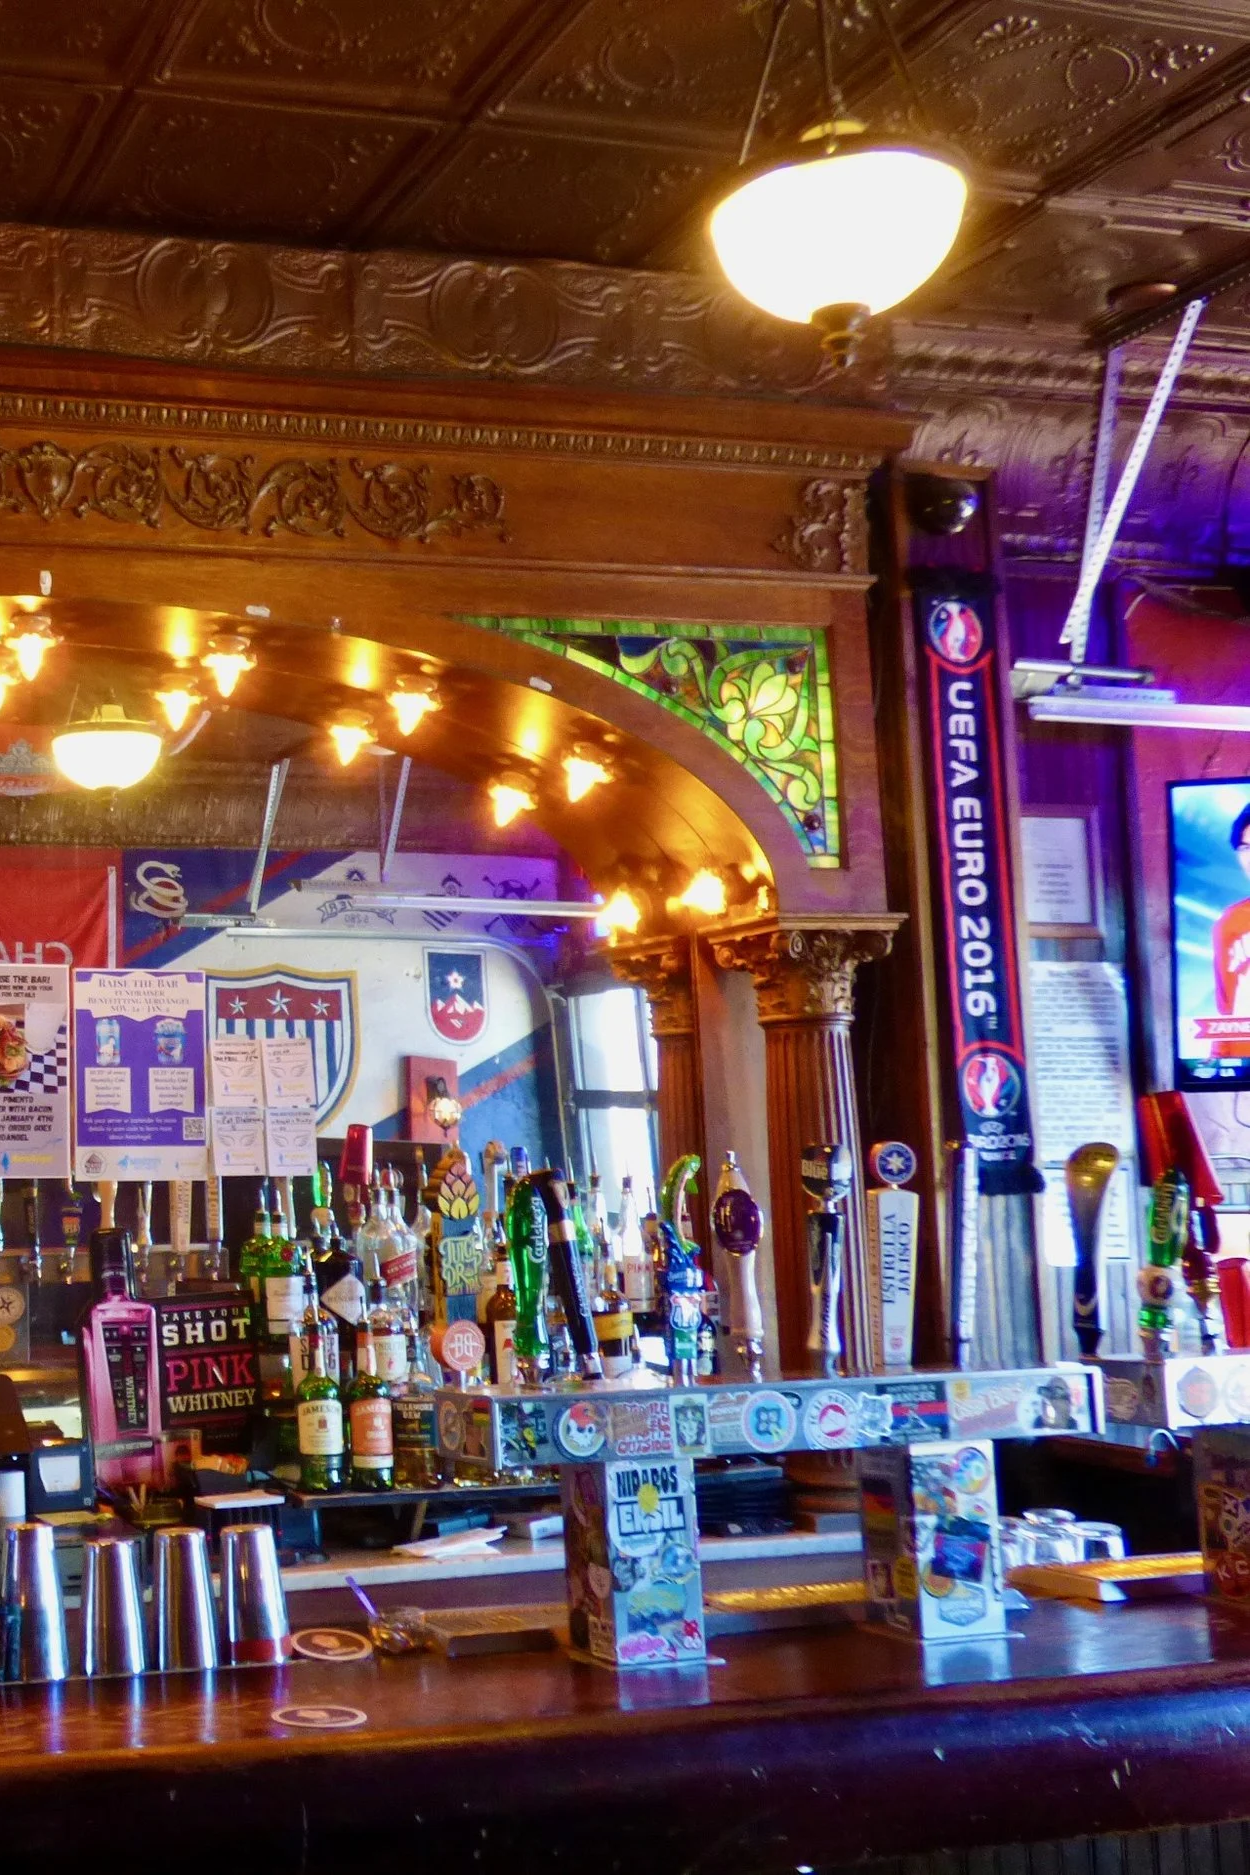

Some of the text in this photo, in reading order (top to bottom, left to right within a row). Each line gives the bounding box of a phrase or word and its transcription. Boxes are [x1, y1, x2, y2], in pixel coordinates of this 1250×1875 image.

[948, 681, 997, 1018] UEFA EURO 2016
[13, 974, 28, 983] THE
[9, 1105, 26, 1113] WITH
[28, 1105, 52, 1113] BACON
[8, 1124, 31, 1132] ORDER
[34, 1124, 52, 1132] GOES
[529, 1196, 549, 1263] Carlsberg
[882, 1213, 896, 1304] ESTRELLA
[898, 1221, 911, 1296] JALISCO
[161, 1306, 250, 1322] TAKE YOUR
[161, 1318, 251, 1347] SHOT
[166, 1353, 255, 1393] PINK
[125, 1375, 138, 1425] WHITNEY
[166, 1388, 256, 1414] WHITNEY
